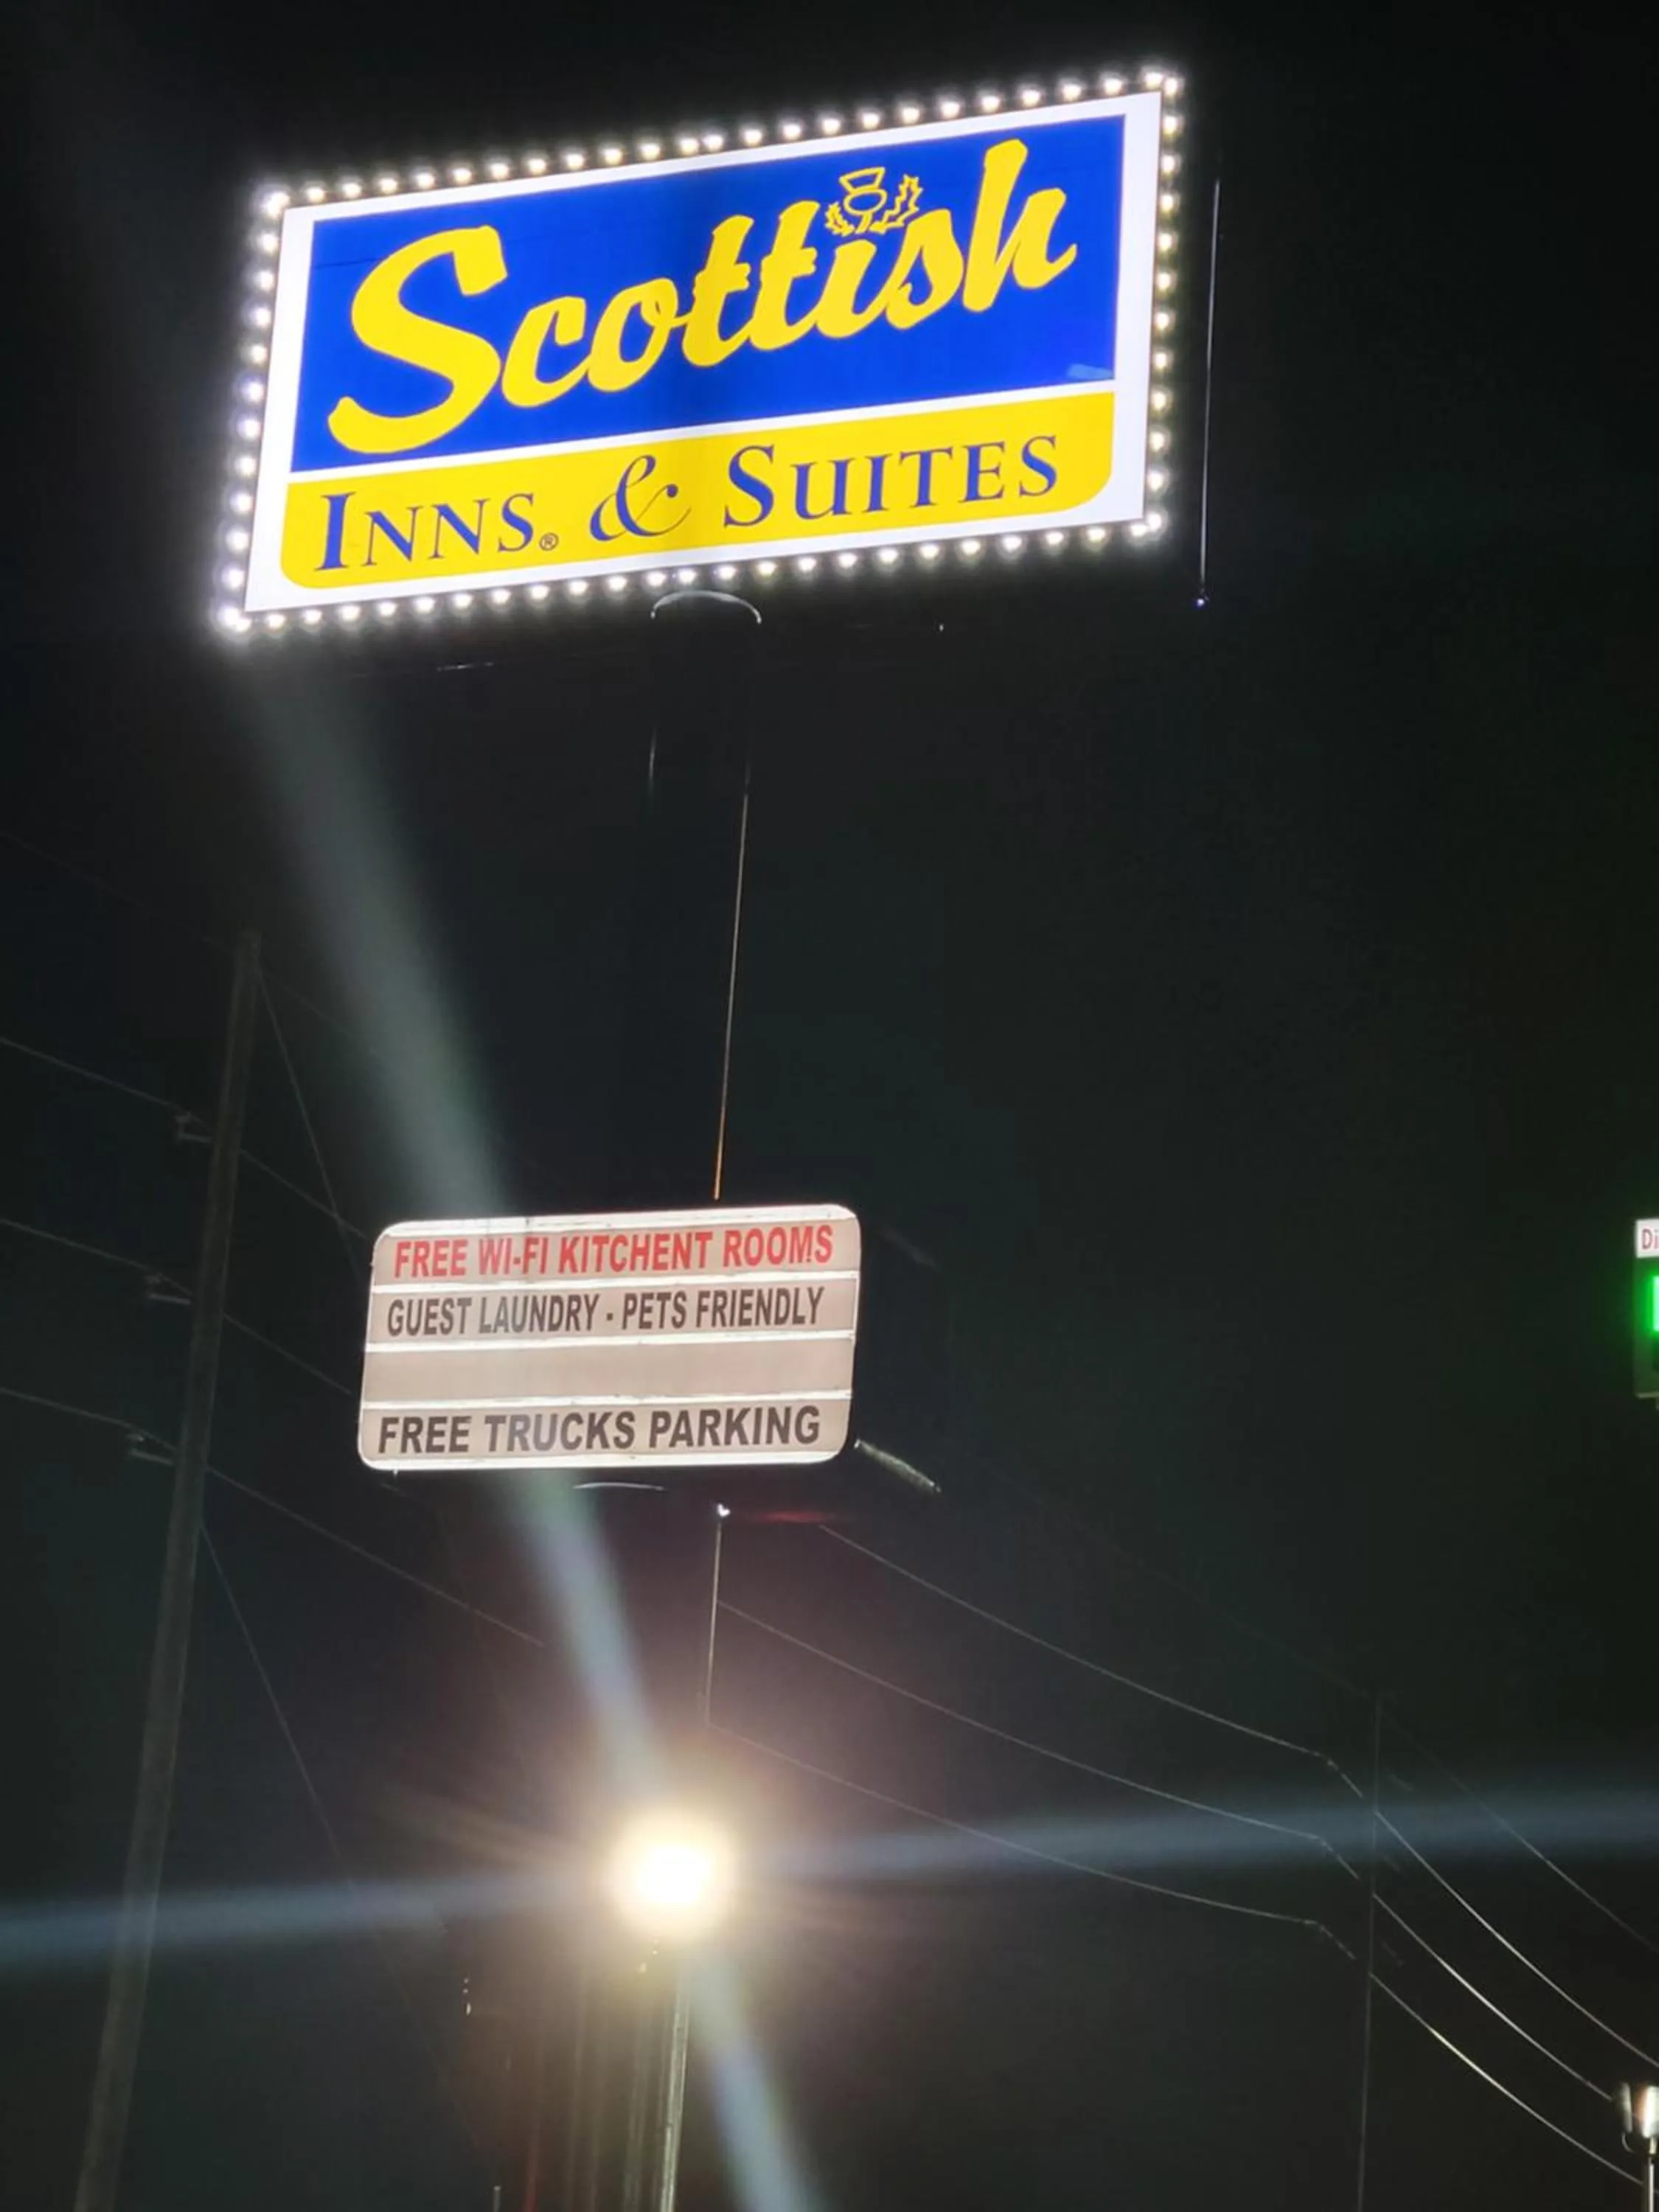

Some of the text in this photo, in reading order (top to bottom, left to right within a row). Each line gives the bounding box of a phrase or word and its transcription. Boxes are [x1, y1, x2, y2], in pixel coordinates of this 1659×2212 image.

[327, 139, 1077, 454] Scottish
[590, 455, 690, 542] &
[723, 435, 1058, 528] SUITES
[394, 1225, 833, 1278] FREE WI-FI KITCHENT ROOMS
[387, 1298, 472, 1336] GUEST
[479, 1294, 599, 1334] LAUNDRY
[622, 1290, 687, 1330] PETS
[696, 1287, 824, 1328] FRIENDLY
[378, 1406, 820, 1454] FREE TRUCKS PARKING
